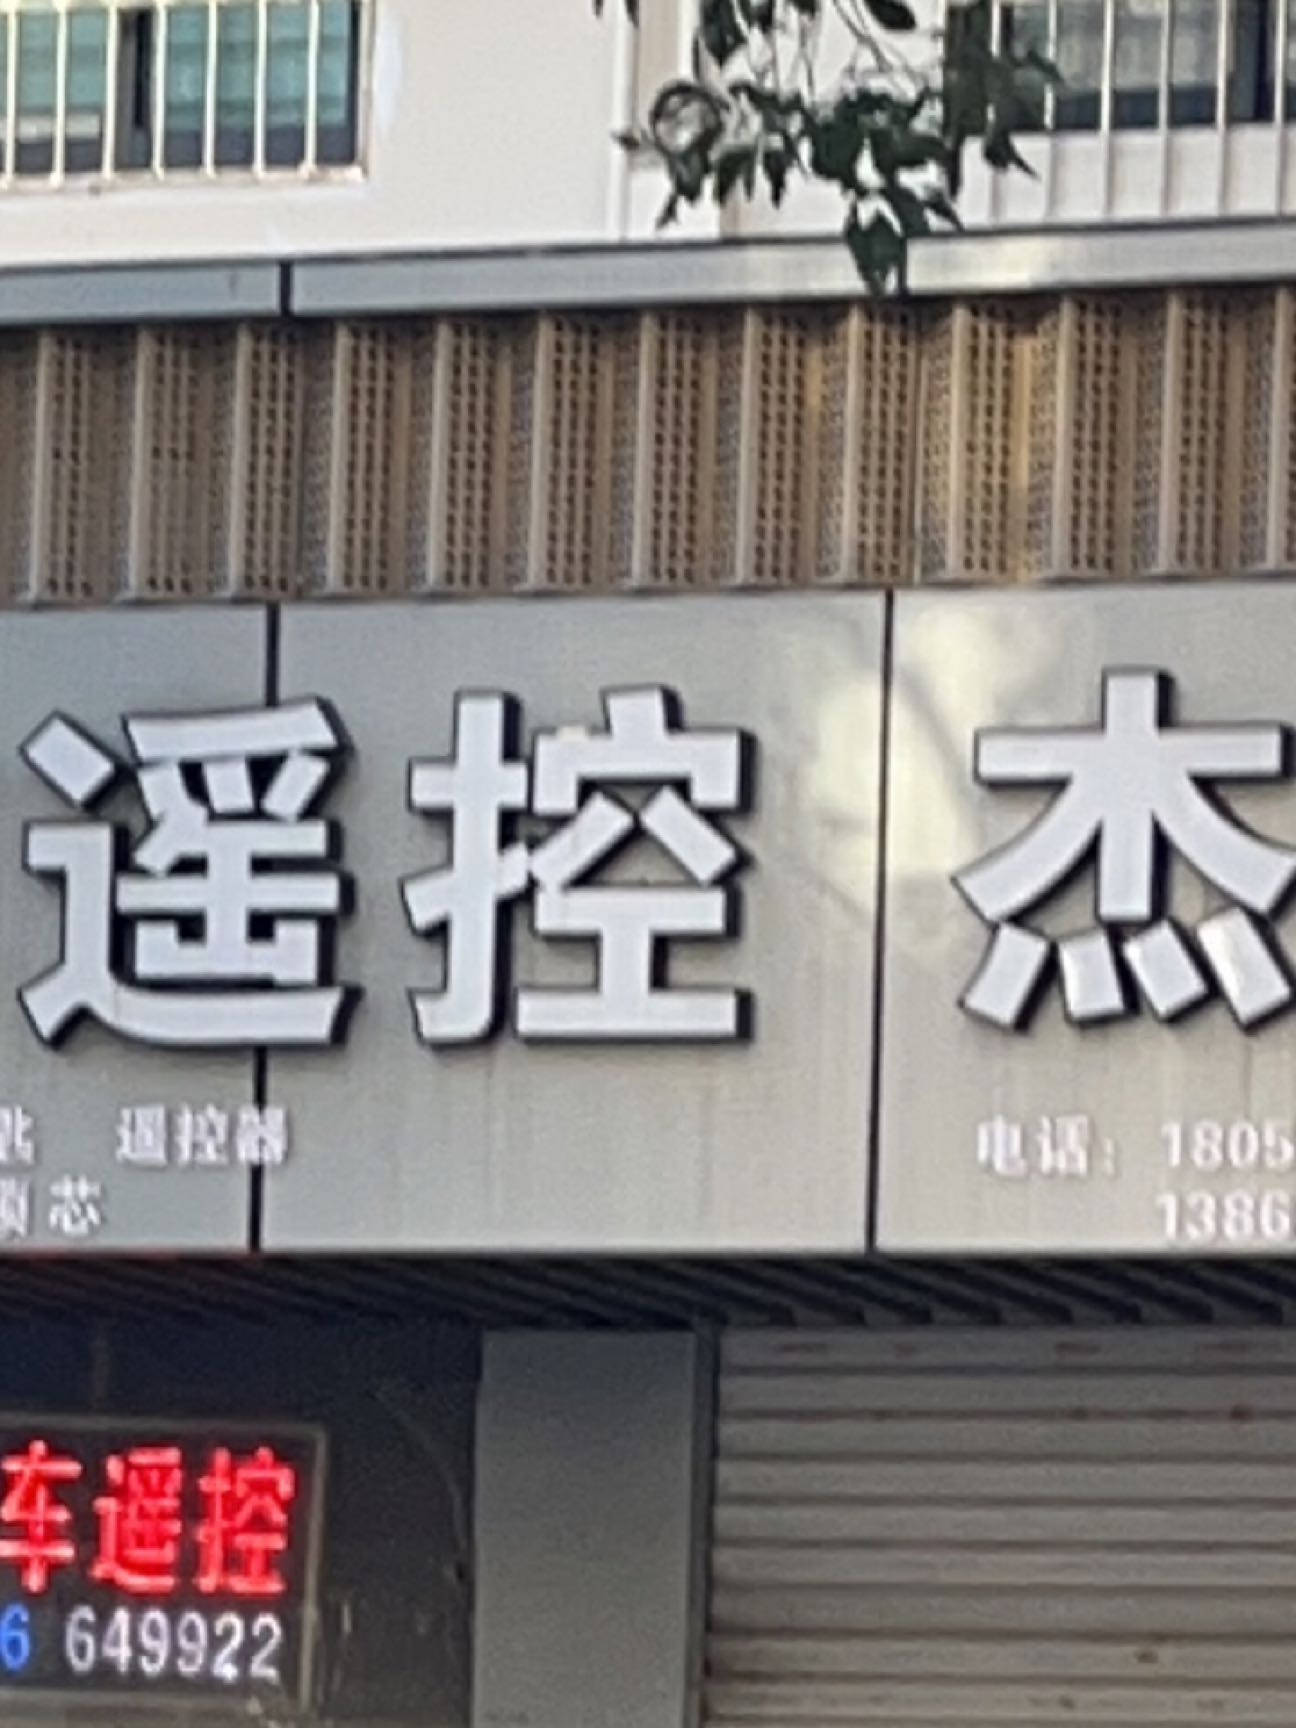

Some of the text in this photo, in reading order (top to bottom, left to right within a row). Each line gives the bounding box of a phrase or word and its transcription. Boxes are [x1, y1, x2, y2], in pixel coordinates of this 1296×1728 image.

[952, 668, 1296, 1028] 杰
[1160, 1118, 1295, 1173] 1805
[1156, 1189, 1292, 1241] 1386
[63, 1601, 288, 1686] 649922
